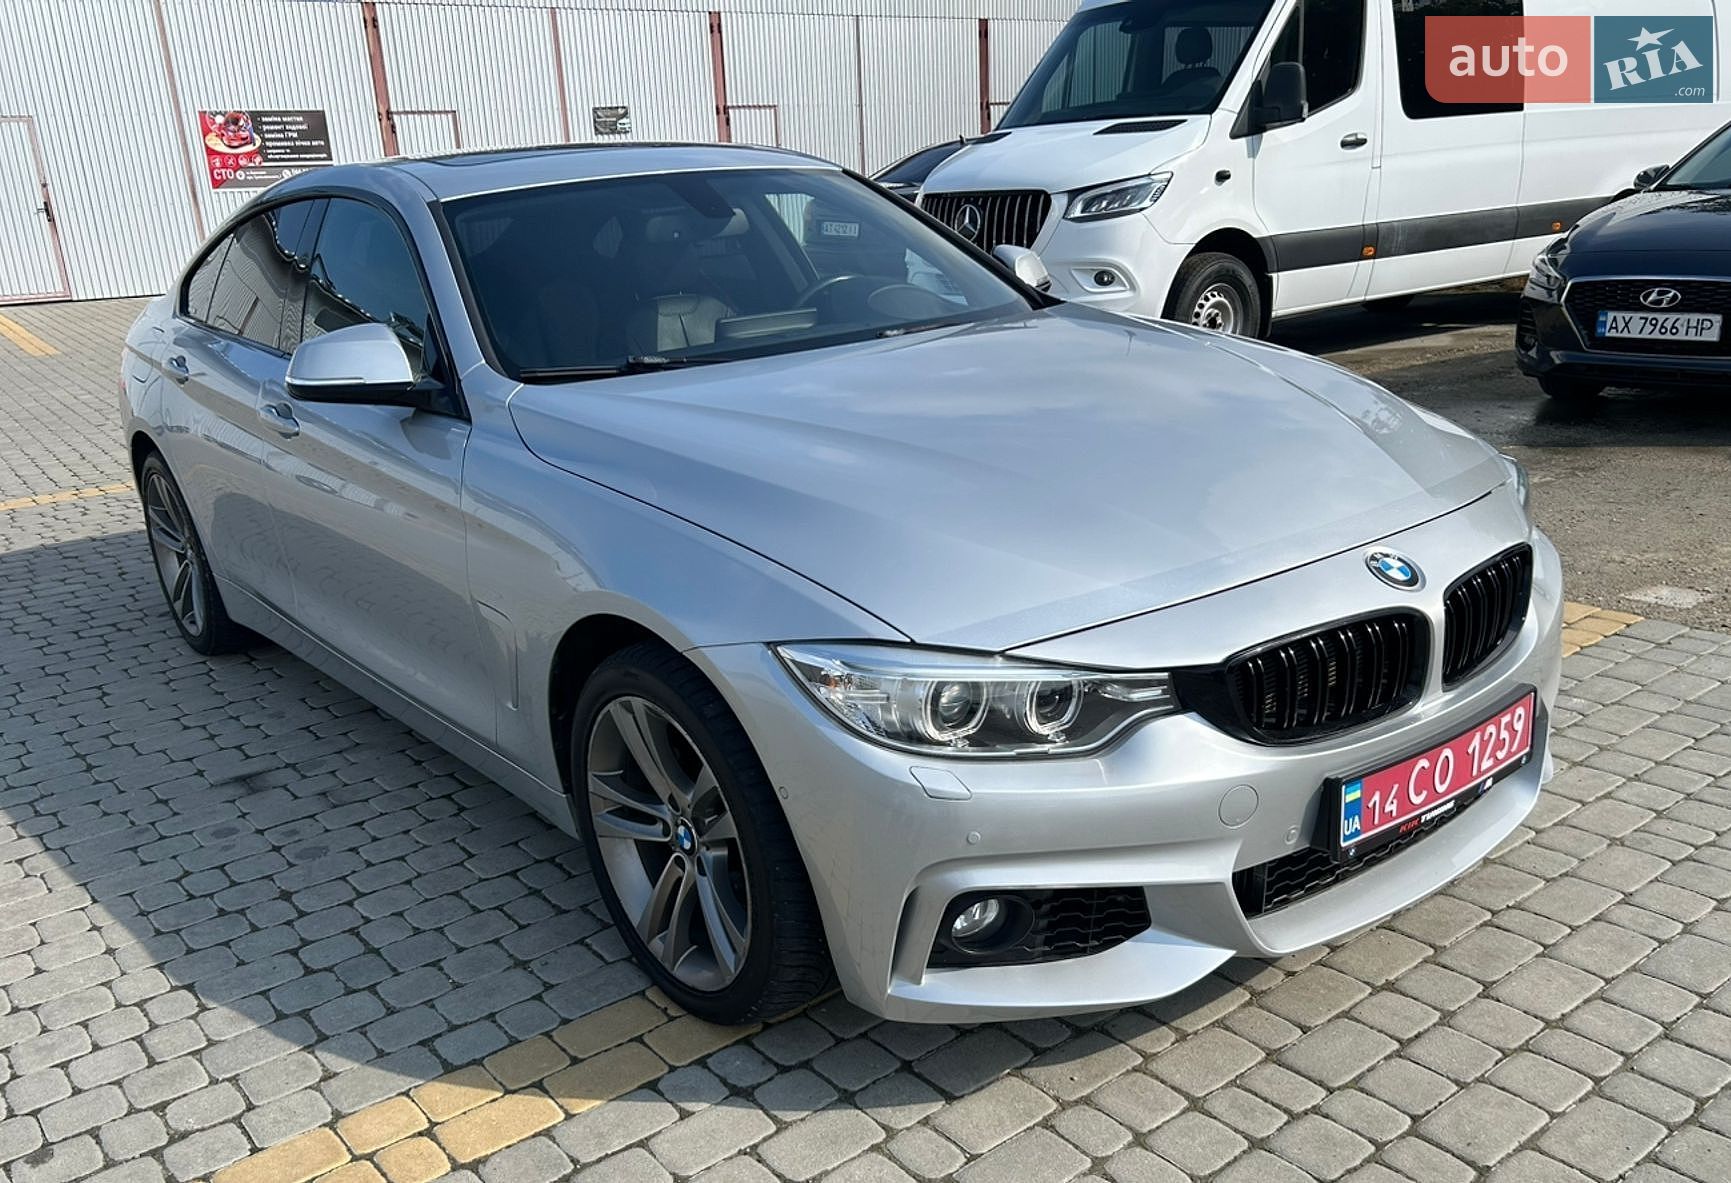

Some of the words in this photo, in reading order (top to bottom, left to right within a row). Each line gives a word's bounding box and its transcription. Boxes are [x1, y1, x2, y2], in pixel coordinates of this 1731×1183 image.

[213, 169, 234, 180] СТО
[1607, 315, 1633, 334] AX
[1638, 316, 1681, 336] 7966
[1685, 317, 1714, 337] HP
[1367, 784, 1399, 825] 14
[1408, 748, 1454, 805] CO
[1467, 706, 1525, 777] 1259
[1344, 815, 1361, 836] UA
